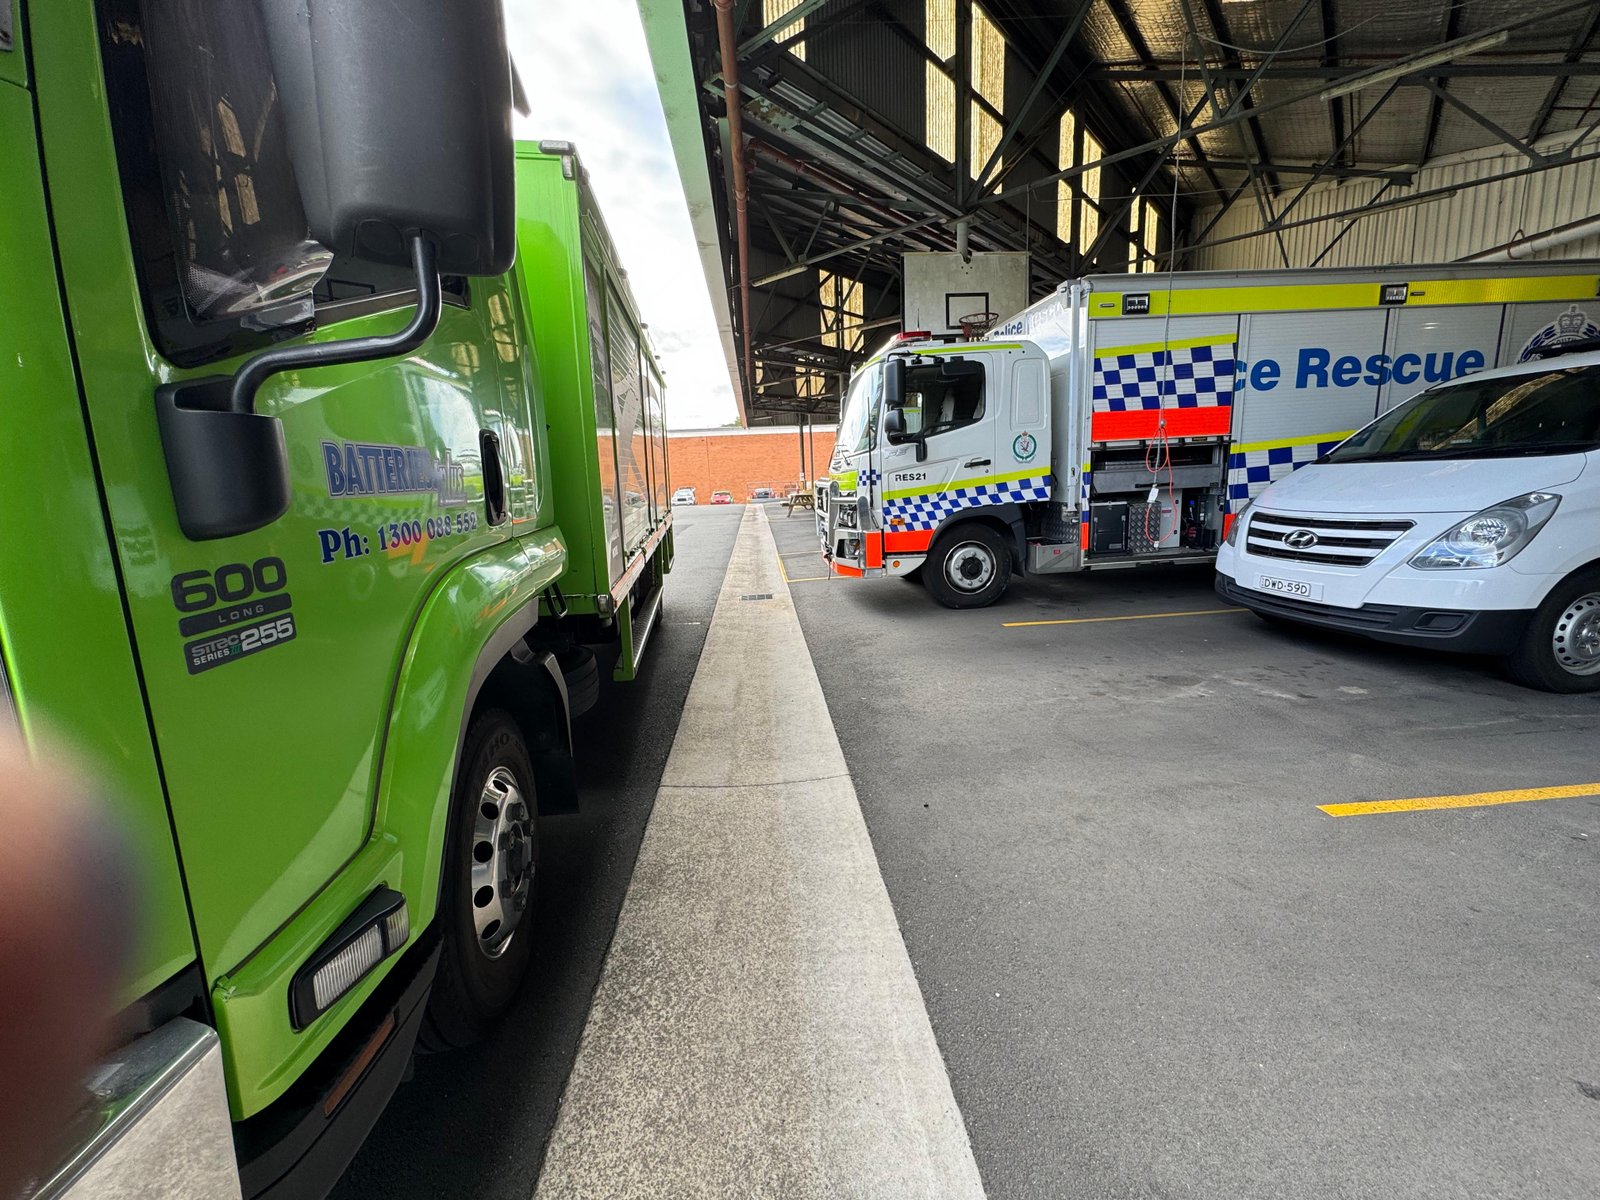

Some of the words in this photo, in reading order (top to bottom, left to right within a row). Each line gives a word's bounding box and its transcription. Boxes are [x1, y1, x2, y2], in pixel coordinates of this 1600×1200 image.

[1295, 347, 1485, 389] Rescue
[895, 472, 927, 482] RES21
[317, 526, 371, 564] Ph:
[376, 519, 423, 551] 1300
[426, 512, 452, 540] 088
[171, 556, 288, 613] 600
[218, 604, 265, 624] LONG
[240, 617, 294, 652] 255
[193, 648, 230, 666] SERIES
